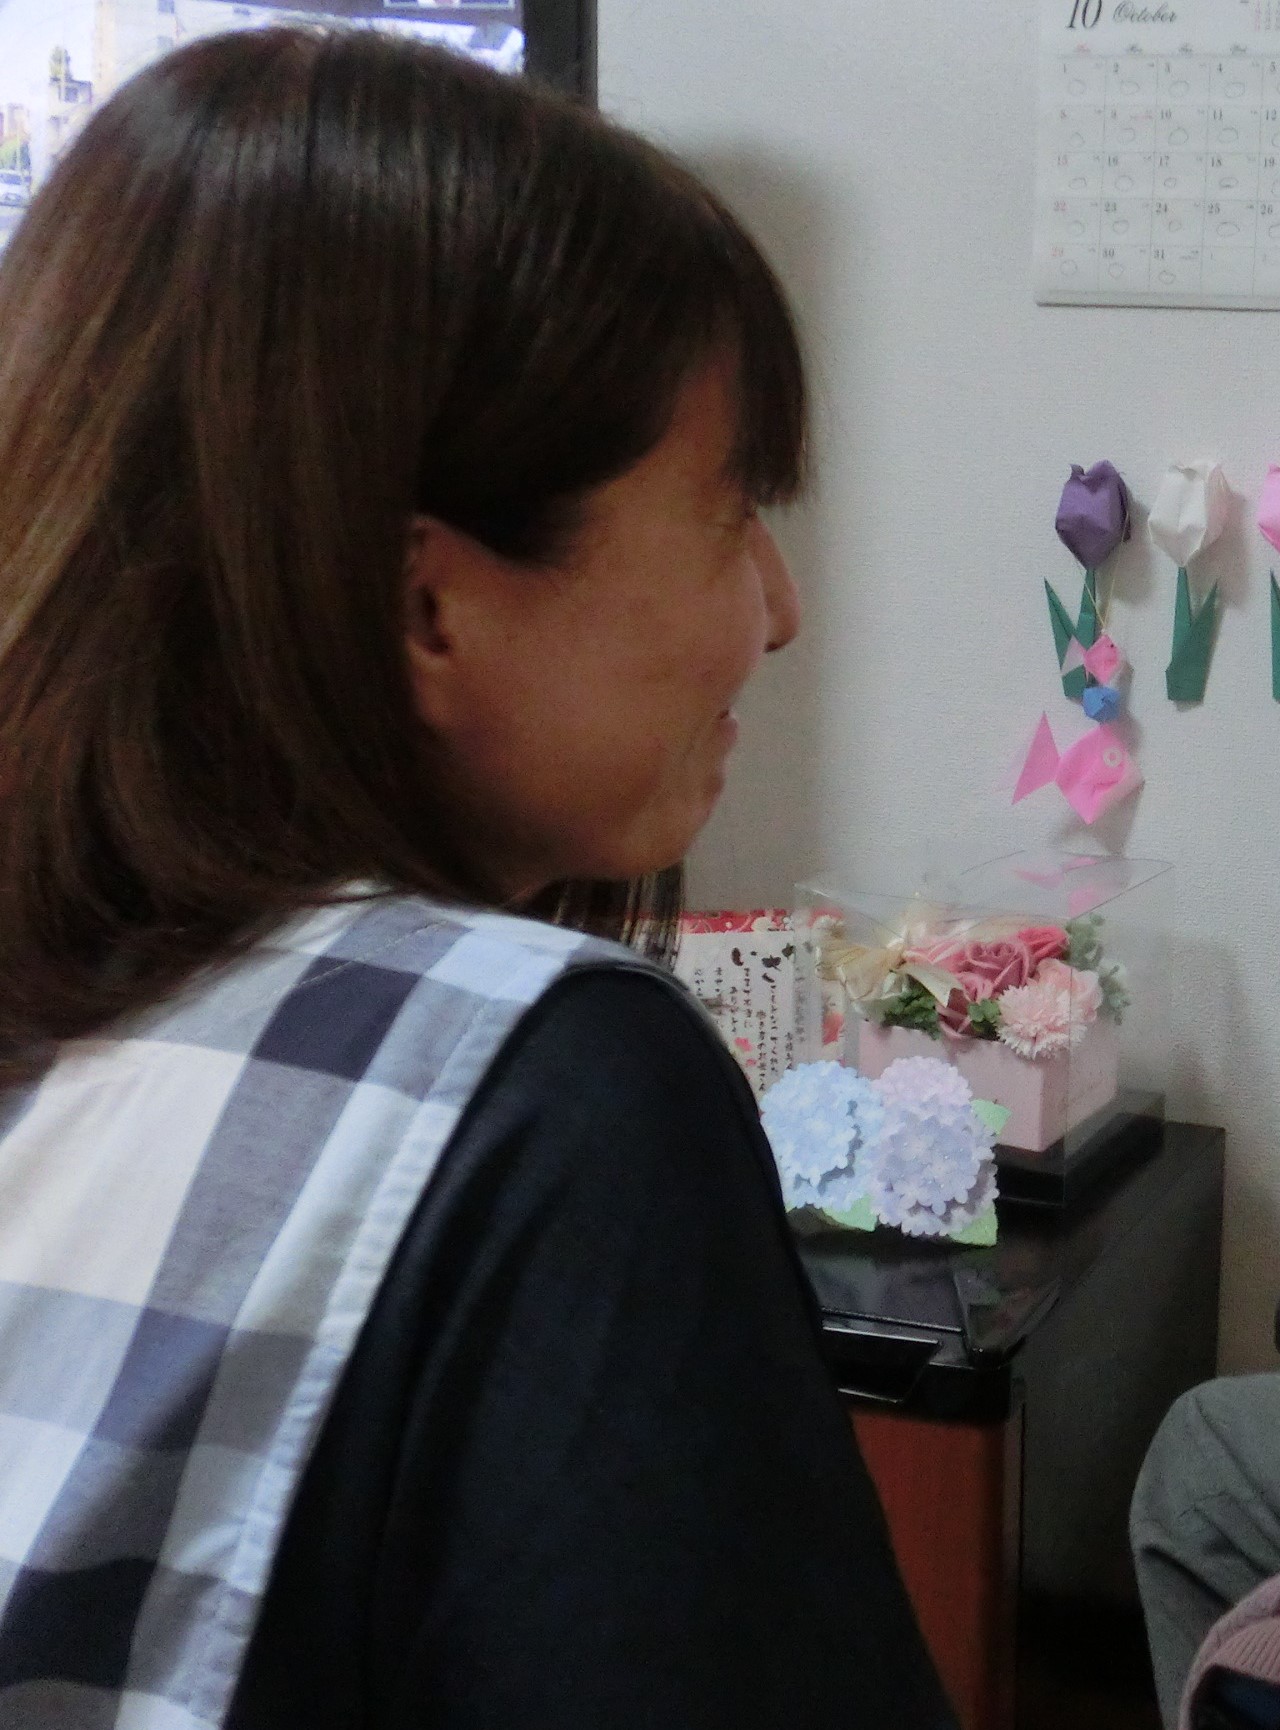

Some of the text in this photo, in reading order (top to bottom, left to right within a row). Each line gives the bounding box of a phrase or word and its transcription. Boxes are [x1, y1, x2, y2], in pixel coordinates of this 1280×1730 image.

[1067, 0, 1178, 29] 10 October
[1160, 109, 1172, 120] 10
[1213, 109, 1223, 120] 11
[1265, 110, 1277, 120] 12
[1107, 155, 1119, 166] 16
[1159, 155, 1170, 166] 17
[1211, 156, 1223, 167] 18
[1263, 158, 1275, 168] 19
[1053, 201, 1067, 212] 22
[1104, 201, 1117, 212] 23
[1155, 202, 1168, 213] 24
[1207, 202, 1221, 214] 25
[1260, 204, 1273, 215] 26
[1102, 248, 1115, 258] 30
[1154, 249, 1165, 259] 31
